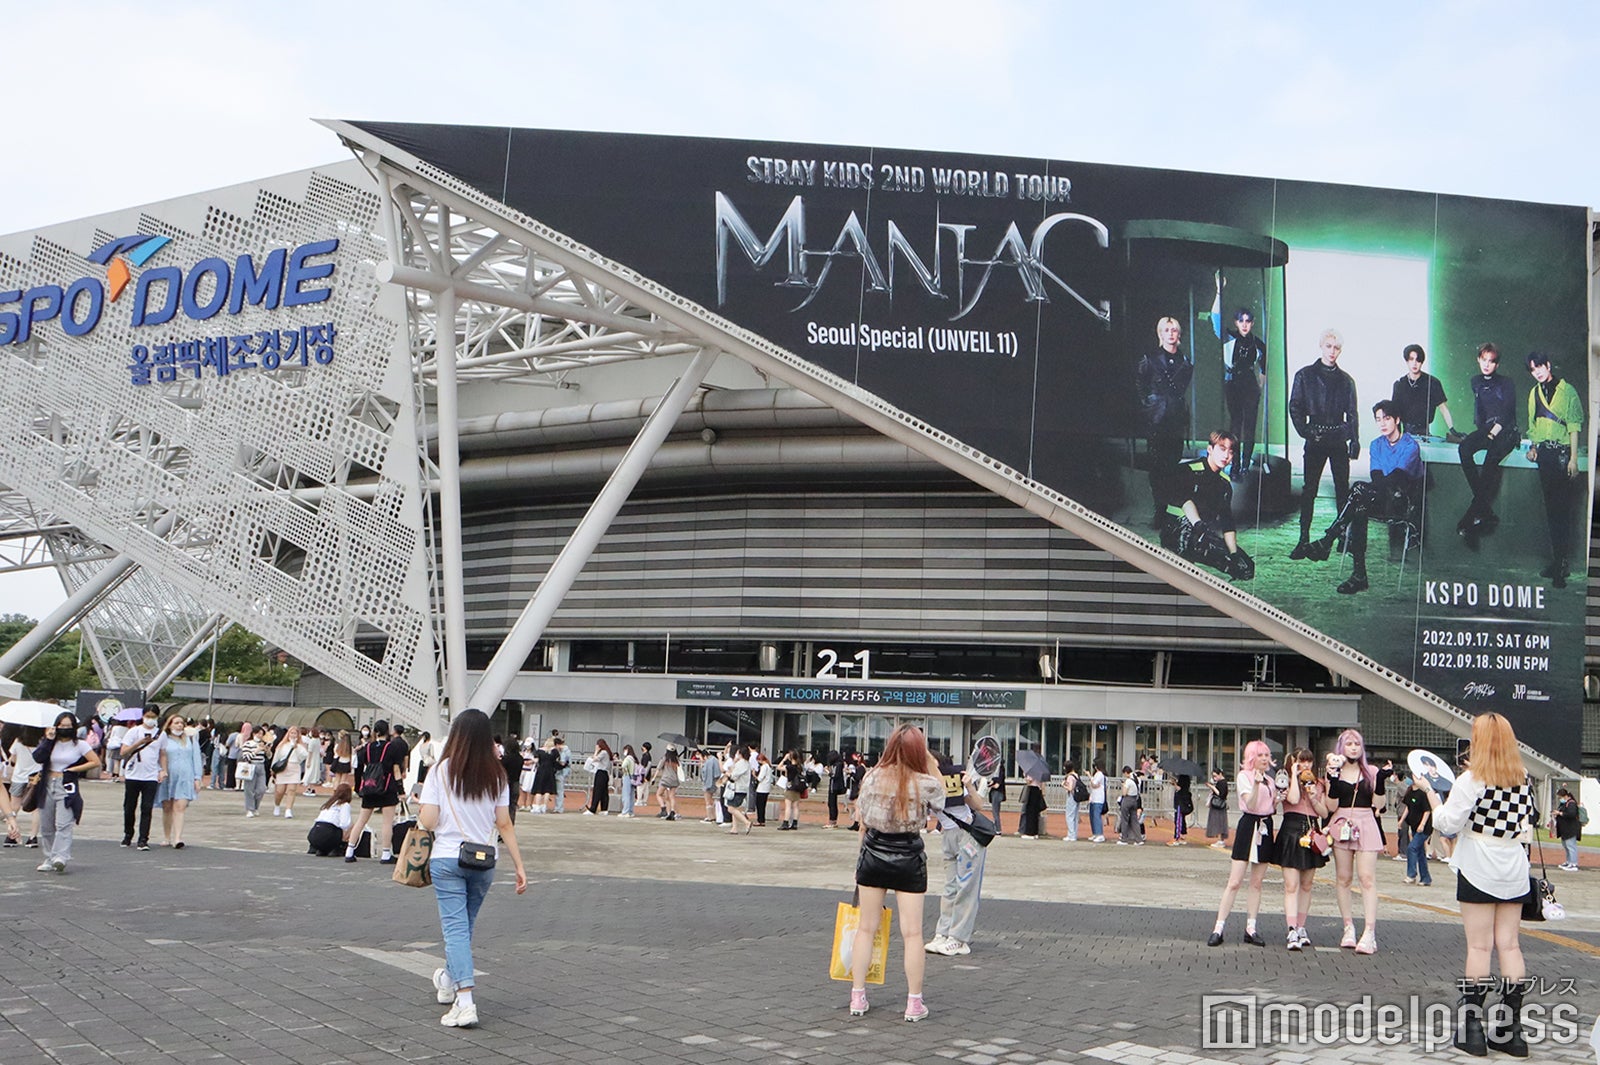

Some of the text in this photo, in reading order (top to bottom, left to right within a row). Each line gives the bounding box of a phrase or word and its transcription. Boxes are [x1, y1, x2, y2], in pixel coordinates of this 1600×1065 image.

[746, 156, 1072, 203] STRAY KIDS 2ND WORLD TOUR
[131, 238, 340, 327] DOME
[127, 322, 337, 386] 올림픽체조경기장
[807, 321, 1018, 358] Seoul Special (UNVEIL 11)
[1425, 581, 1545, 609] KSPO DOME
[1423, 630, 1550, 650] 2022.09.17. SAT 6PM
[815, 649, 872, 680] 2-1
[1422, 652, 1549, 671] 2022.09.18. SUN 5PM
[731, 686, 750, 697] 2-1
[752, 687, 781, 699] GATE
[784, 688, 821, 700] FLOOR
[822, 689, 834, 700] F1
[836, 690, 849, 701] F2
[851, 690, 865, 701] F5
[866, 691, 880, 702] F6
[883, 691, 903, 703] 구역
[905, 691, 926, 704] 입장
[929, 692, 960, 705] 게이트
[1512, 684, 1526, 700] JYP
